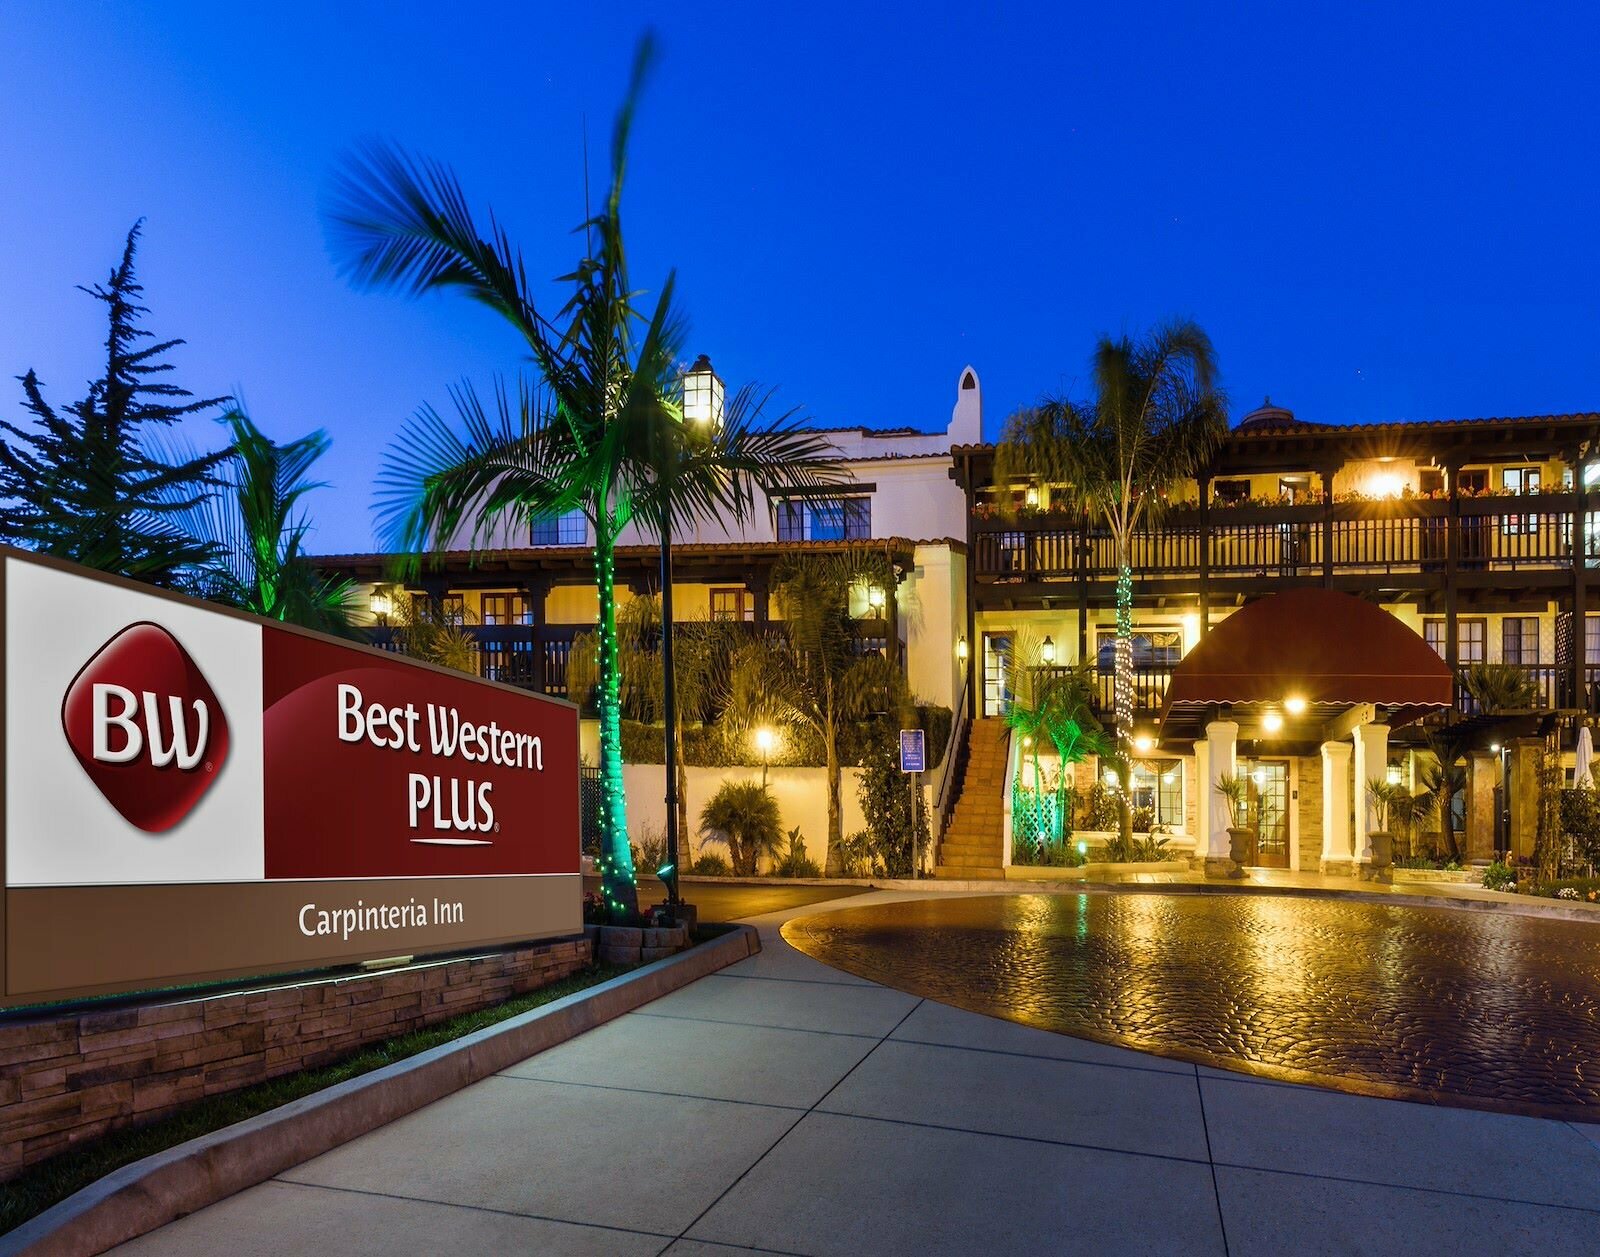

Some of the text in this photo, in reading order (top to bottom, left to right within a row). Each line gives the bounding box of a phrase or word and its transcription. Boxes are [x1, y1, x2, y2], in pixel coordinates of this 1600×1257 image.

[92, 683, 209, 770] BW
[337, 683, 544, 770] Best Western
[408, 773, 495, 833] PLUS
[298, 897, 464, 940] Carpinteria Inn
